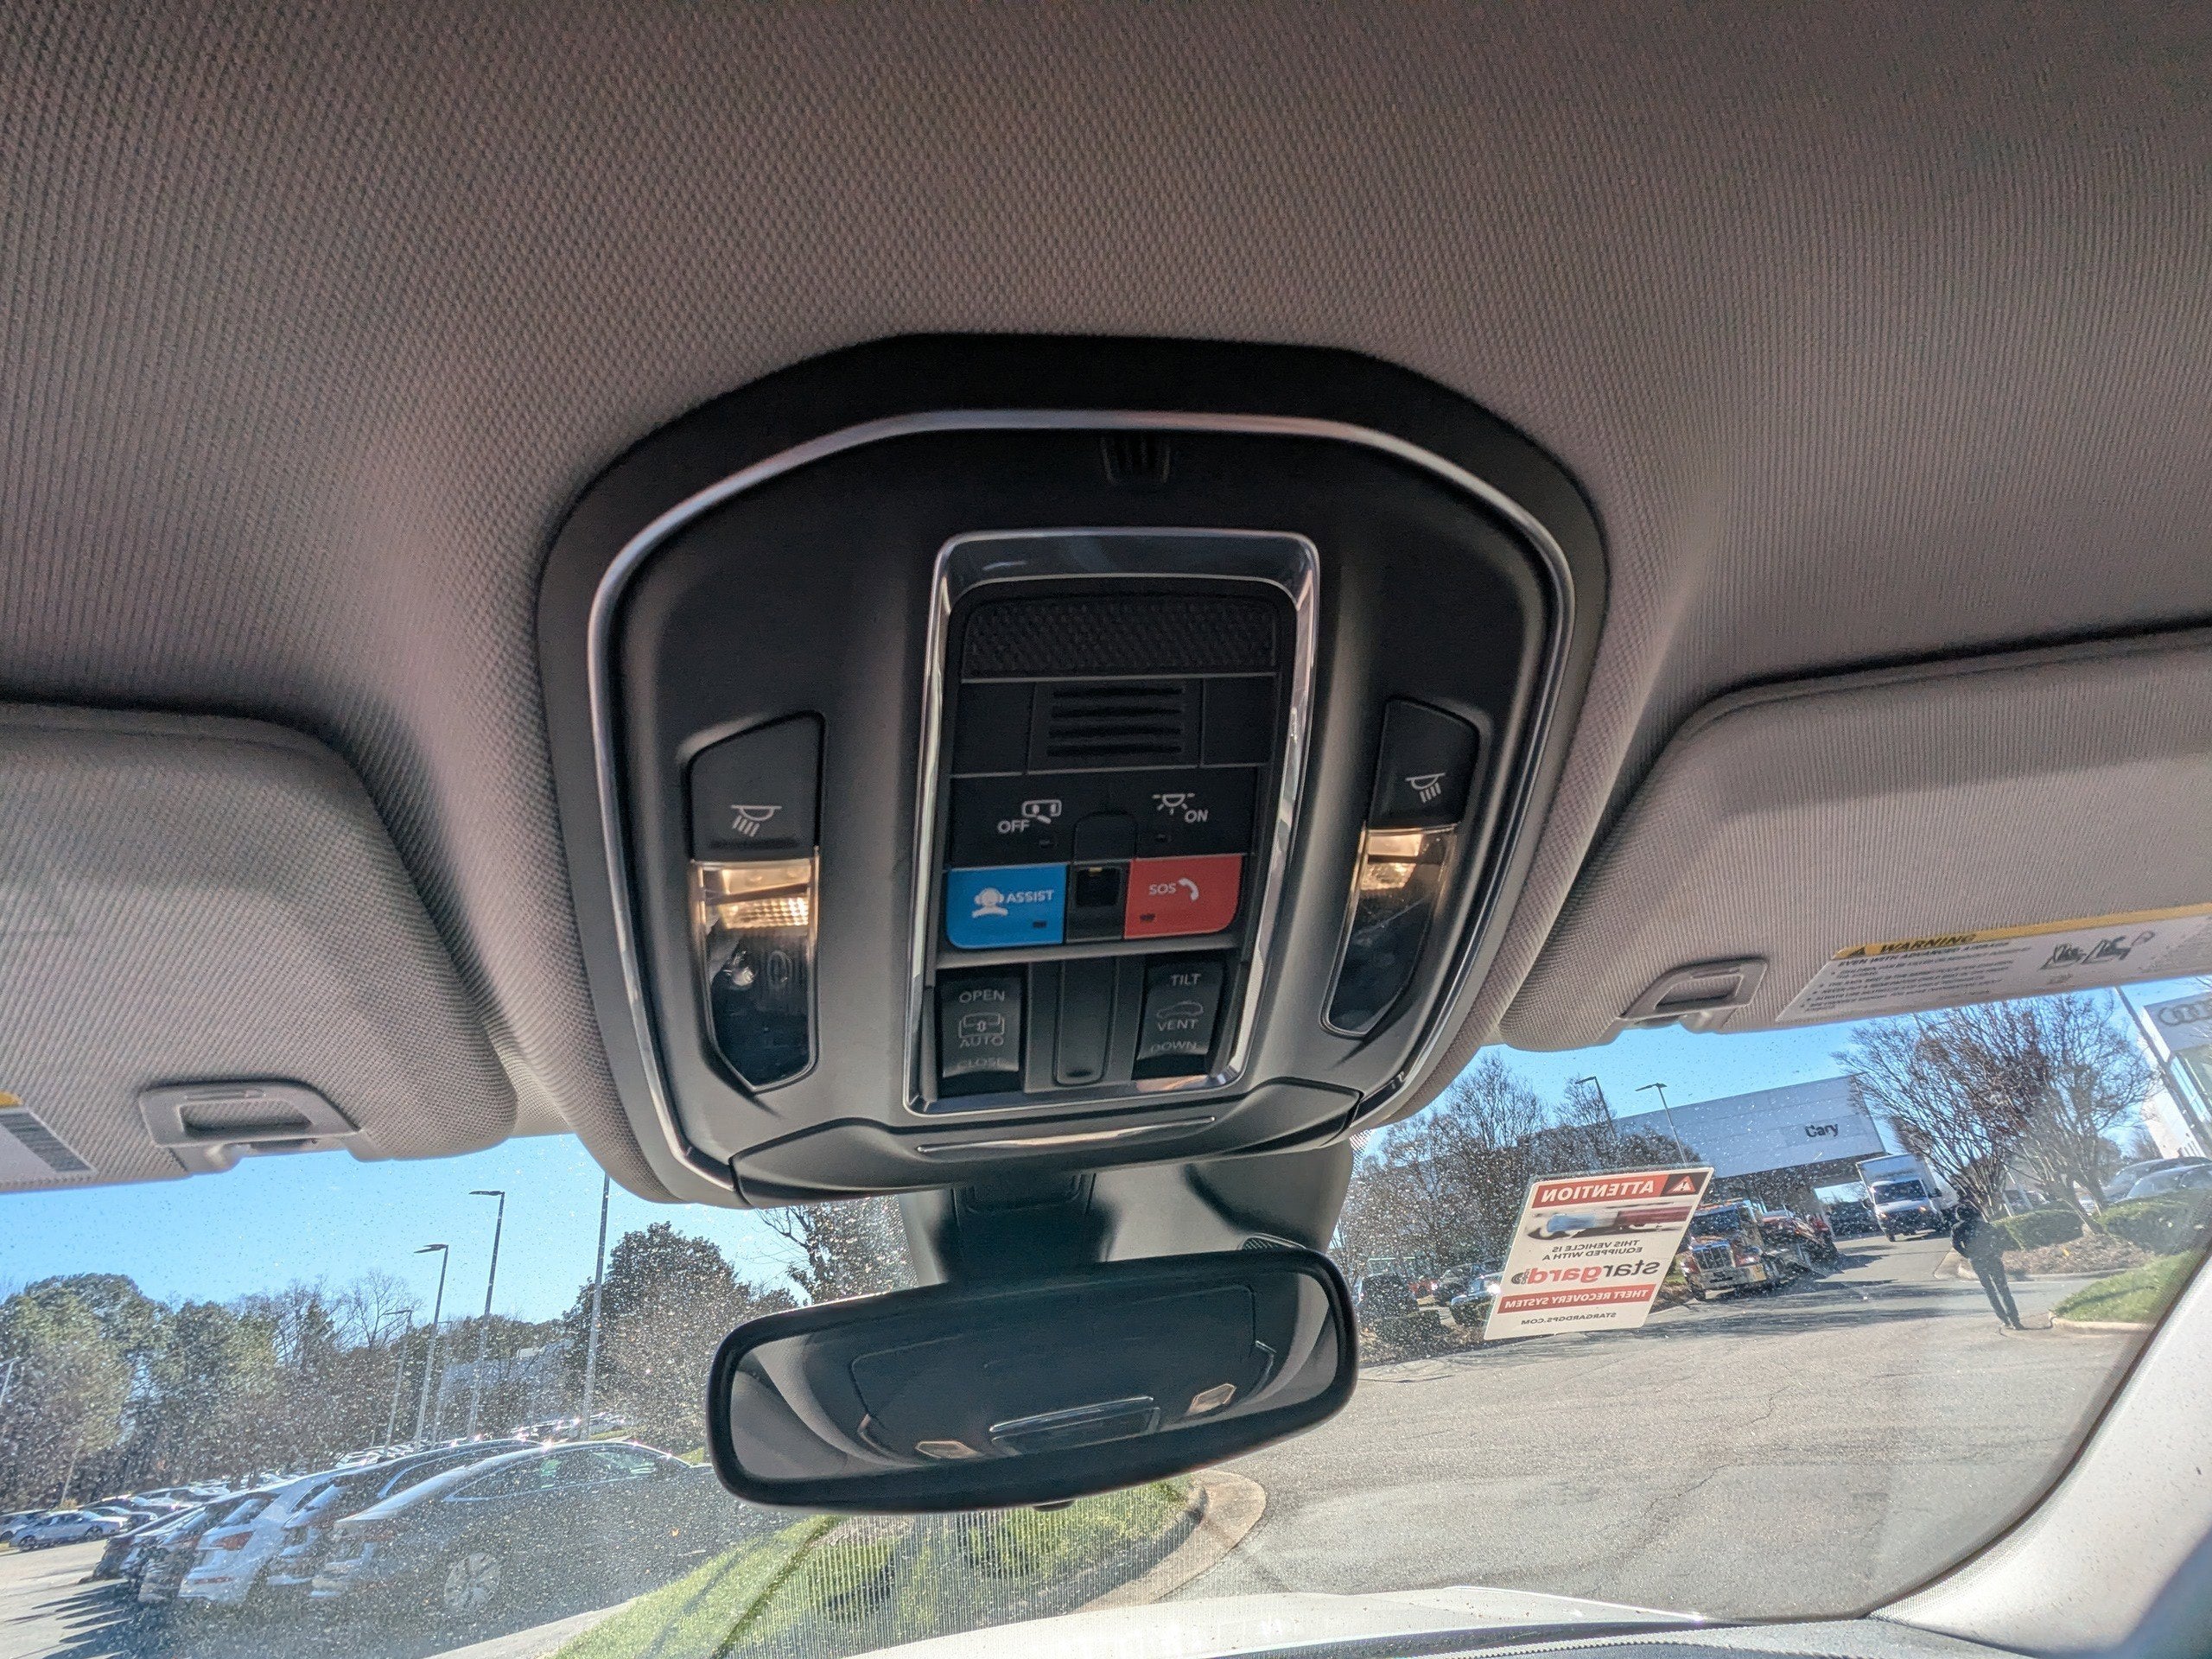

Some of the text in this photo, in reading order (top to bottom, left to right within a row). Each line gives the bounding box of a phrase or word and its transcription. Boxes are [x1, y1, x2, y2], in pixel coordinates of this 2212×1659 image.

[1184, 808, 1209, 823] ON
[997, 818, 1030, 835] OFF
[1006, 889, 1055, 905] ASSIST
[1148, 883, 1177, 896] SOS
[1880, 934, 1977, 954] WARNING
[1169, 973, 1202, 986] TILT
[958, 989, 1006, 1004] OPEN
[1156, 1019, 1199, 1032] VENT
[959, 1035, 1004, 1048] AUTO
[1150, 1039, 1198, 1054] DOWN
[1804, 1123, 1840, 1138] Cary
